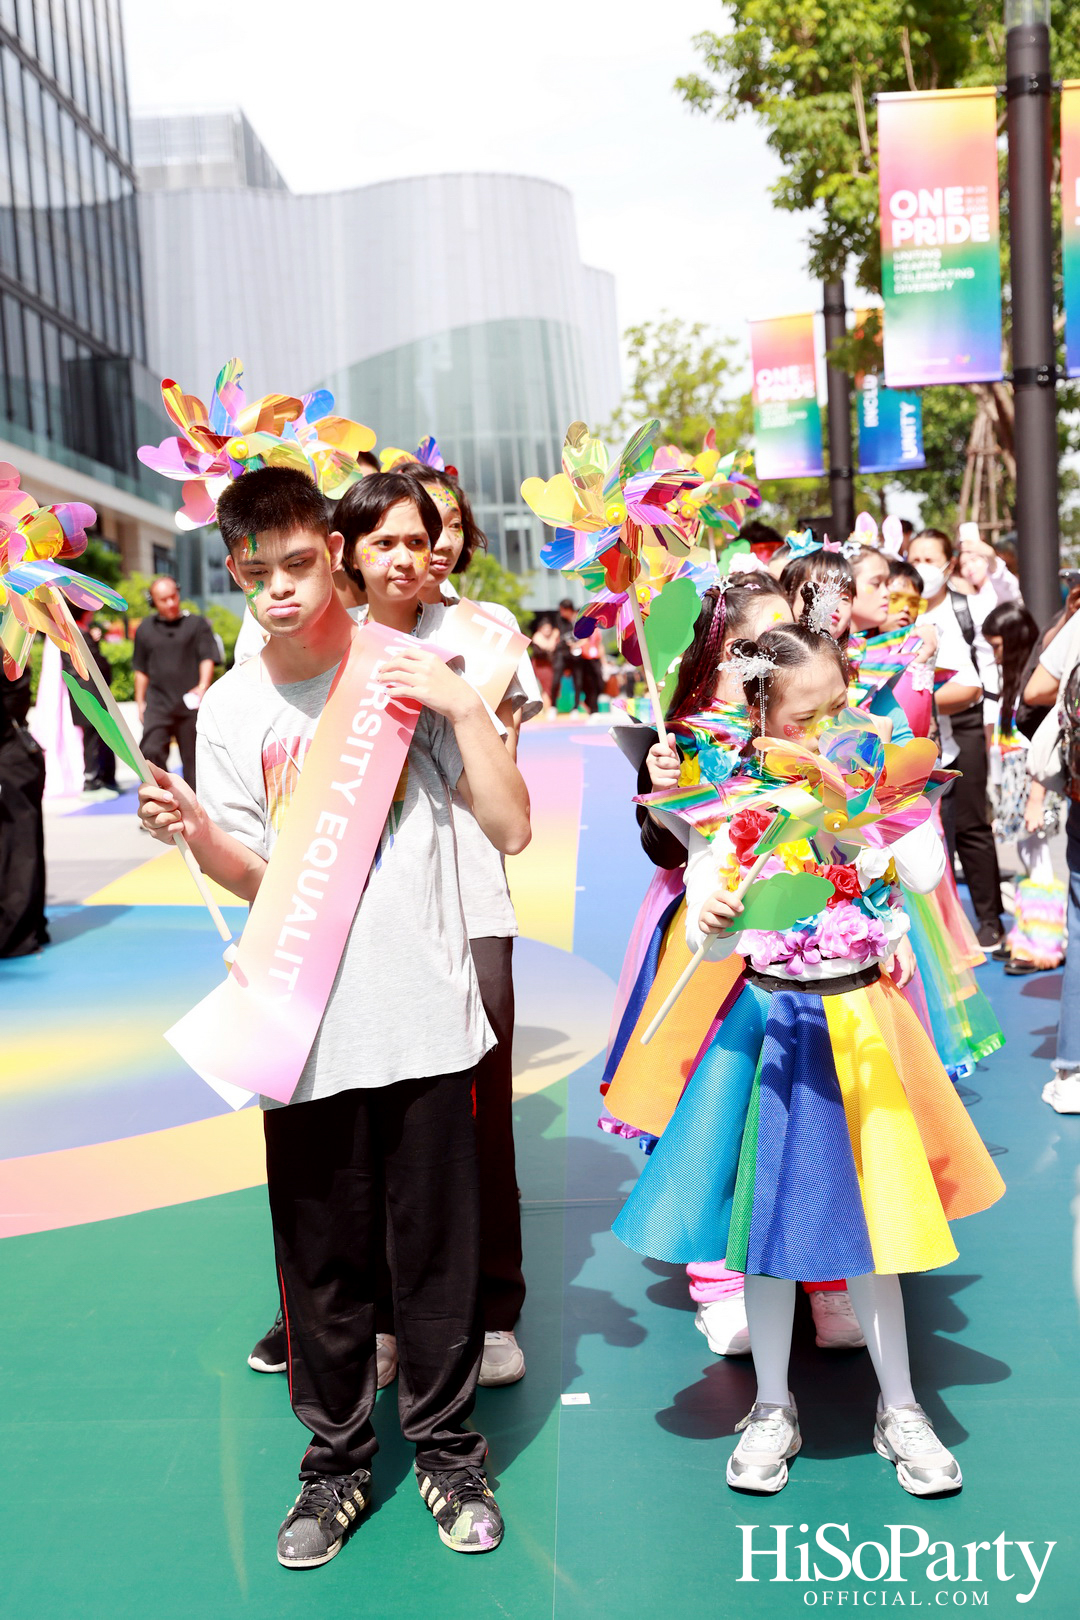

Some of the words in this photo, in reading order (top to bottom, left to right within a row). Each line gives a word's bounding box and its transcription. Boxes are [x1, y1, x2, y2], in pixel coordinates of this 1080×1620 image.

[889, 186, 965, 219] ONE
[891, 213, 990, 248] PRIDE
[756, 365, 799, 388] ONE
[900, 401, 918, 459] UNITY
